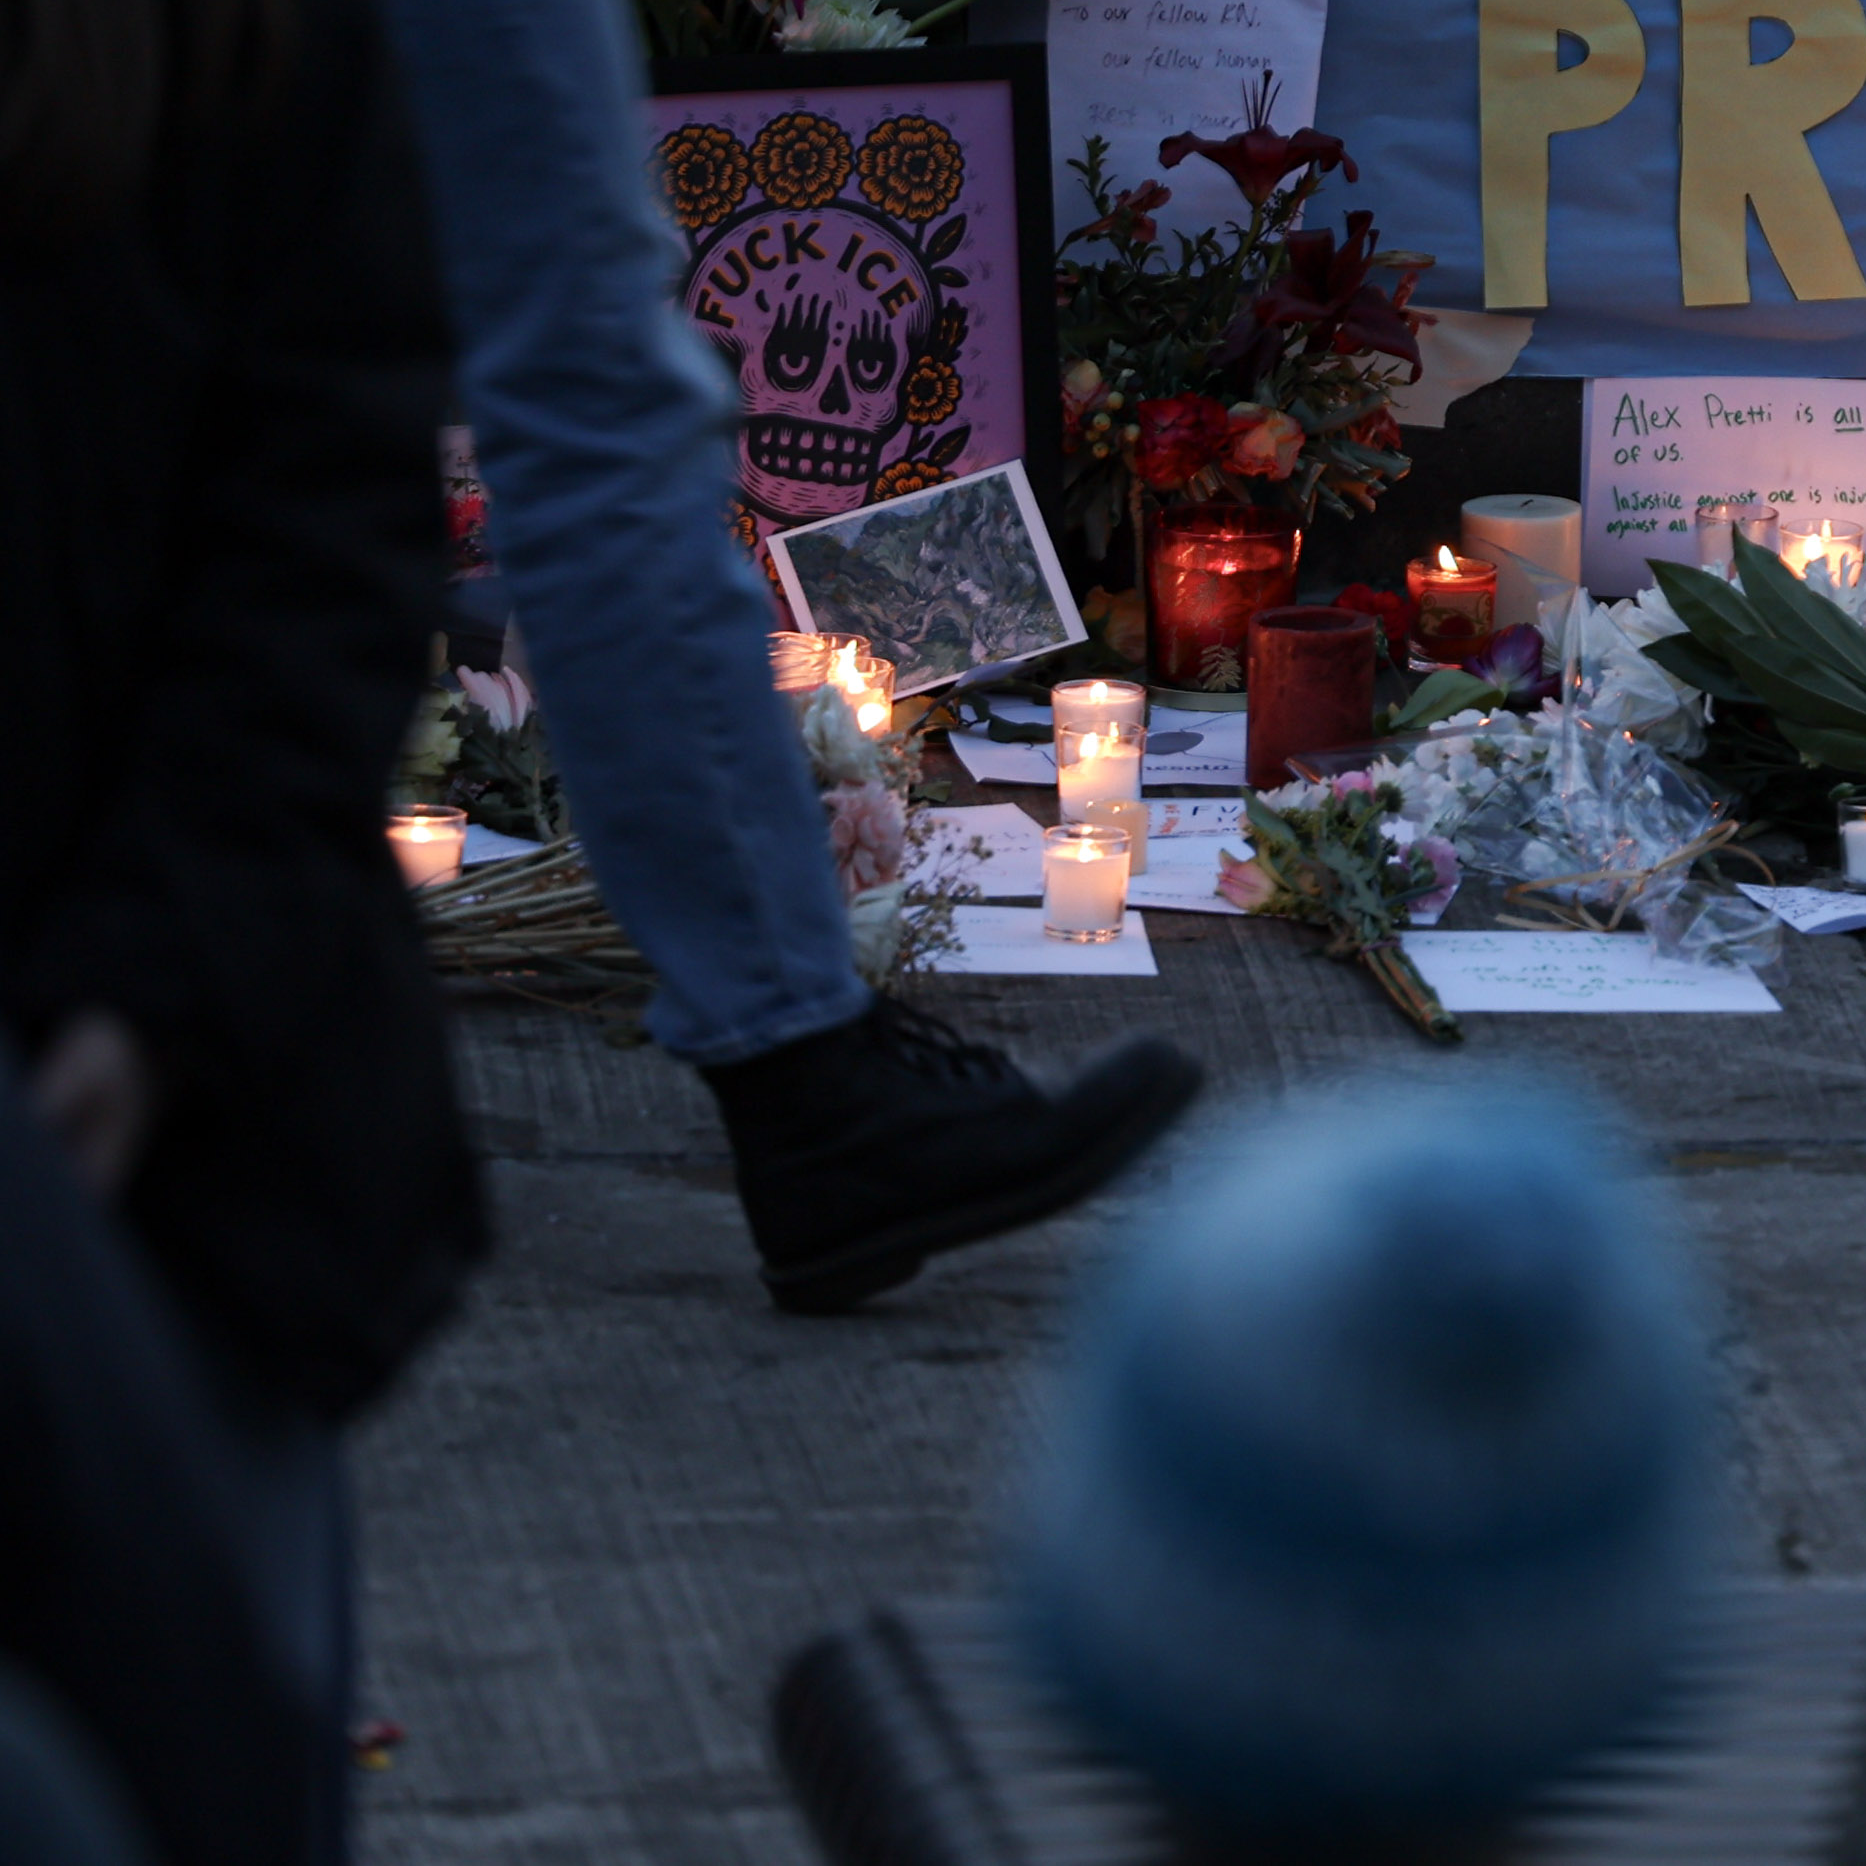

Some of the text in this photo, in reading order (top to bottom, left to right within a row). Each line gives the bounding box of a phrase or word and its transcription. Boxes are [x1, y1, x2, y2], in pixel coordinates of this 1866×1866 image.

[1062, 0, 1209, 31] To our fellow
[1103, 46, 1272, 75] our fellow human
[695, 220, 920, 330] FUCK ICE
[1613, 393, 1863, 436] Alex Pretti is all
[1614, 443, 1684, 465] of us.
[1613, 485, 1682, 512] Injustice
[1697, 491, 1757, 516] against
[1768, 490, 1797, 504] one
[1809, 486, 1822, 504] is
[1606, 518, 1688, 538] against all
